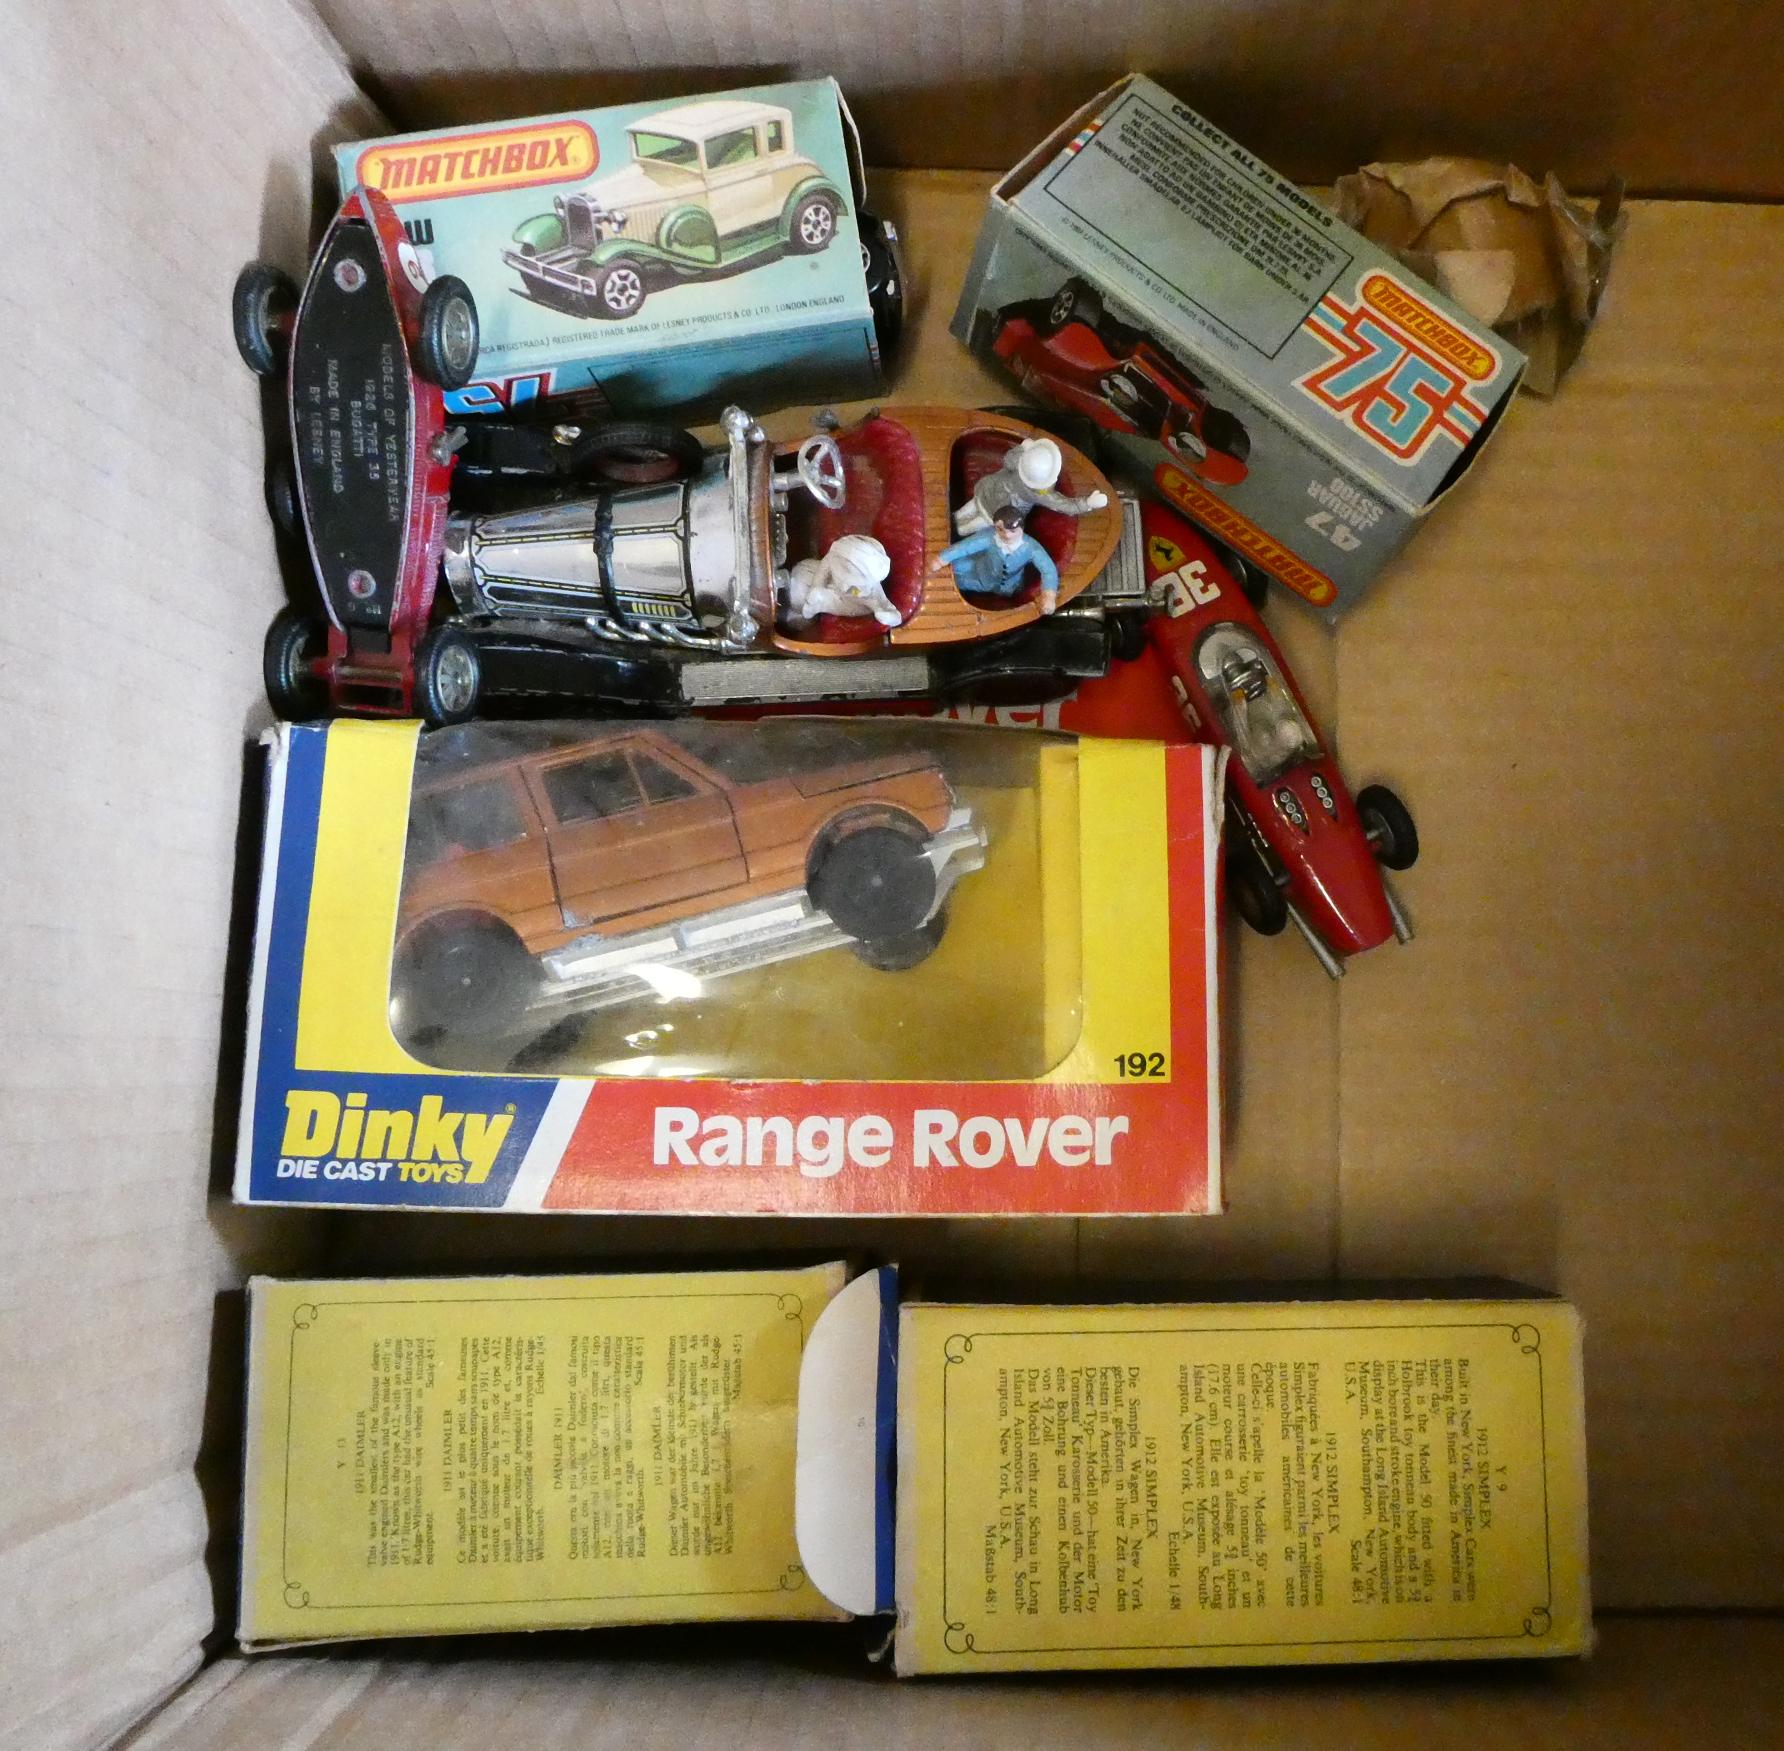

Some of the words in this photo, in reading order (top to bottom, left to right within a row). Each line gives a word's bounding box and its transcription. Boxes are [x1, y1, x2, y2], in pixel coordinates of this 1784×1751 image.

[377, 133, 583, 190] MATCHBOX
[1169, 102, 1232, 151] COLLECT
[1229, 146, 1257, 171] ALL
[1254, 167, 1276, 186] 75
[1274, 182, 1335, 229] MODELS
[626, 323, 648, 334] MARK
[775, 300, 807, 312] LONDON
[808, 295, 844, 307] ENGLAND
[1372, 283, 1481, 367] MATCHBOX
[327, 359, 338, 398] MADE
[1308, 310, 1462, 458] 75
[350, 400, 363, 457] BUGATTI
[383, 408, 394, 425] OF
[329, 429, 343, 493] ENGLAND
[1306, 478, 1374, 532] JAGUAR
[1304, 511, 1364, 553] 47
[1113, 1053, 1165, 1077] 192
[280, 1091, 515, 1184] Dinky
[653, 1107, 894, 1178] Range
[913, 1109, 1129, 1168] Rover
[277, 1159, 318, 1178] DIE
[323, 1161, 393, 1180] CAST
[398, 1163, 463, 1183] TOYS
[1028, 1368, 1039, 1392] Das
[1370, 1360, 1385, 1403] display
[1388, 1360, 1399, 1386] inch
[1402, 1360, 1414, 1420] Holbrook
[1416, 1360, 1427, 1386] This
[1430, 1358, 1441, 1386] their
[1441, 1358, 1452, 1401] among
[1028, 1401, 1039, 1445] Modell
[1375, 1407, 1386, 1420] at
[1418, 1414, 1429, 1433] the
[1446, 1406, 1457, 1424] the
[1460, 1409, 1472, 1438] New
[356, 1410, 364, 1467] DAIMLER
[443, 1408, 451, 1465] DAIMLER
[1145, 1437, 1156, 1464] 1912
[1325, 1432, 1337, 1460] 1912
[1375, 1424, 1386, 1443] the
[1401, 1428, 1415, 1446] toy
[553, 1433, 562, 1489] DAIMLER
[1028, 1451, 1039, 1481] steht
[1373, 1447, 1388, 1480] Long
[1390, 1446, 1402, 1485] stroke
[1405, 1453, 1417, 1504] tonneau
[1419, 1444, 1431, 1484] Model
[1028, 1487, 1036, 1507] zur
[1145, 1469, 1157, 1538] SIMPLEX
[1326, 1465, 1338, 1533] SIMPLEX
[1377, 1484, 1389, 1522] Island
[1420, 1494, 1431, 1508] 50
[1448, 1472, 1460, 1505] made
[1477, 1461, 1490, 1528] SIMPLEX
[1028, 1516, 1039, 1554] Schau
[1403, 1510, 1418, 1541] body
[1449, 1512, 1460, 1523] in
[1167, 1531, 1179, 1577] Echelle
[1349, 1539, 1361, 1572] Scale
[1363, 1529, 1375, 1558] New
[1408, 1547, 1419, 1570] and
[1450, 1530, 1462, 1583] America
[1028, 1561, 1039, 1573] in
[1378, 1527, 1391, 1603] Automotive
[1422, 1559, 1434, 1586] with
[1025, 1580, 1040, 1614] Long
